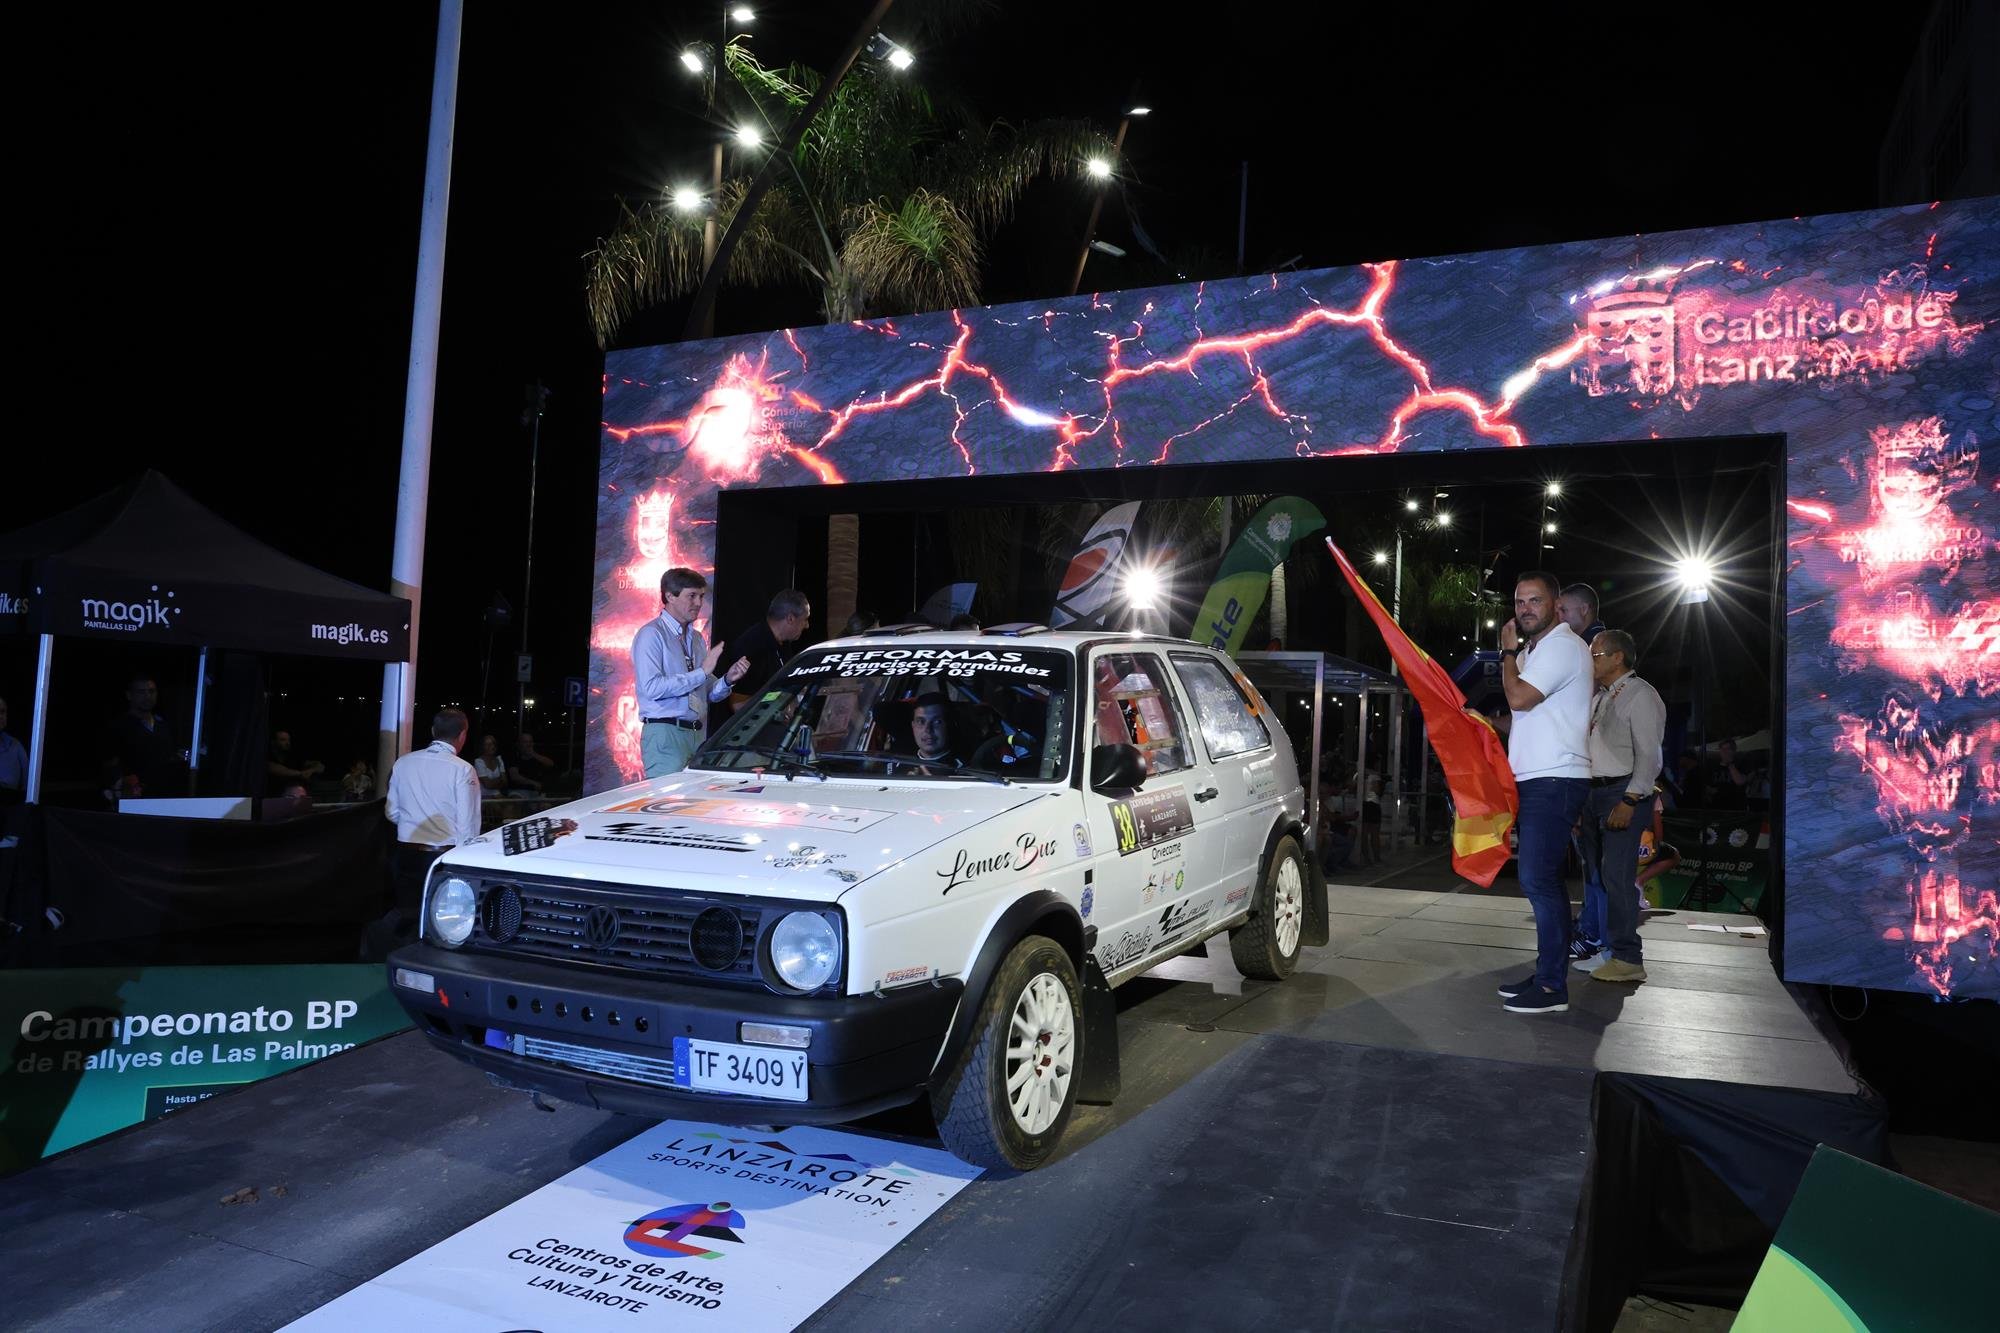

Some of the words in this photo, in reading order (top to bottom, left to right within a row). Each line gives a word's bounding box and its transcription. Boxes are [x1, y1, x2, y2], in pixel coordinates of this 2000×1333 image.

[1884, 292, 1945, 331] de
[82, 598, 170, 628] magik
[84, 620, 123, 630] PANTALLAS
[124, 622, 138, 632] LED
[311, 622, 389, 645] magik.es
[788, 663, 832, 678] Juan
[836, 659, 931, 671] Francisco
[936, 658, 1051, 677] Fernández
[820, 649, 1023, 664] REFORMAS
[840, 668, 876, 677] 677
[882, 668, 909, 677] 39
[915, 667, 942, 676] 27
[947, 668, 976, 677] 03
[569, 681, 581, 703] P
[1113, 803, 1136, 852] 38
[937, 849, 1011, 896] Lemes
[1013, 832, 1058, 872] Bus
[20, 1005, 294, 1045] Campeonato
[306, 1000, 359, 1031] BP
[16, 1052, 54, 1074] de
[61, 1048, 163, 1074] Rallyes
[170, 1044, 204, 1066] de
[211, 1041, 257, 1064] Las
[678, 1065, 687, 1076] E
[694, 1049, 721, 1079] TF
[727, 1054, 785, 1087] 3409
[790, 1062, 805, 1090] Y
[165, 1095, 197, 1104] Hasta
[646, 1151, 735, 1178] SPORTS
[733, 1169, 892, 1208] DESTINATION
[665, 1137, 911, 1195] LANZAROTE
[507, 1247, 599, 1281] Cultura
[597, 1269, 616, 1290] y
[619, 1274, 722, 1311] Turismo
[535, 1238, 632, 1273] Centros
[632, 1259, 670, 1282] de
[671, 1268, 726, 1297] Arte,
[527, 1275, 649, 1313] LANZAROTE
